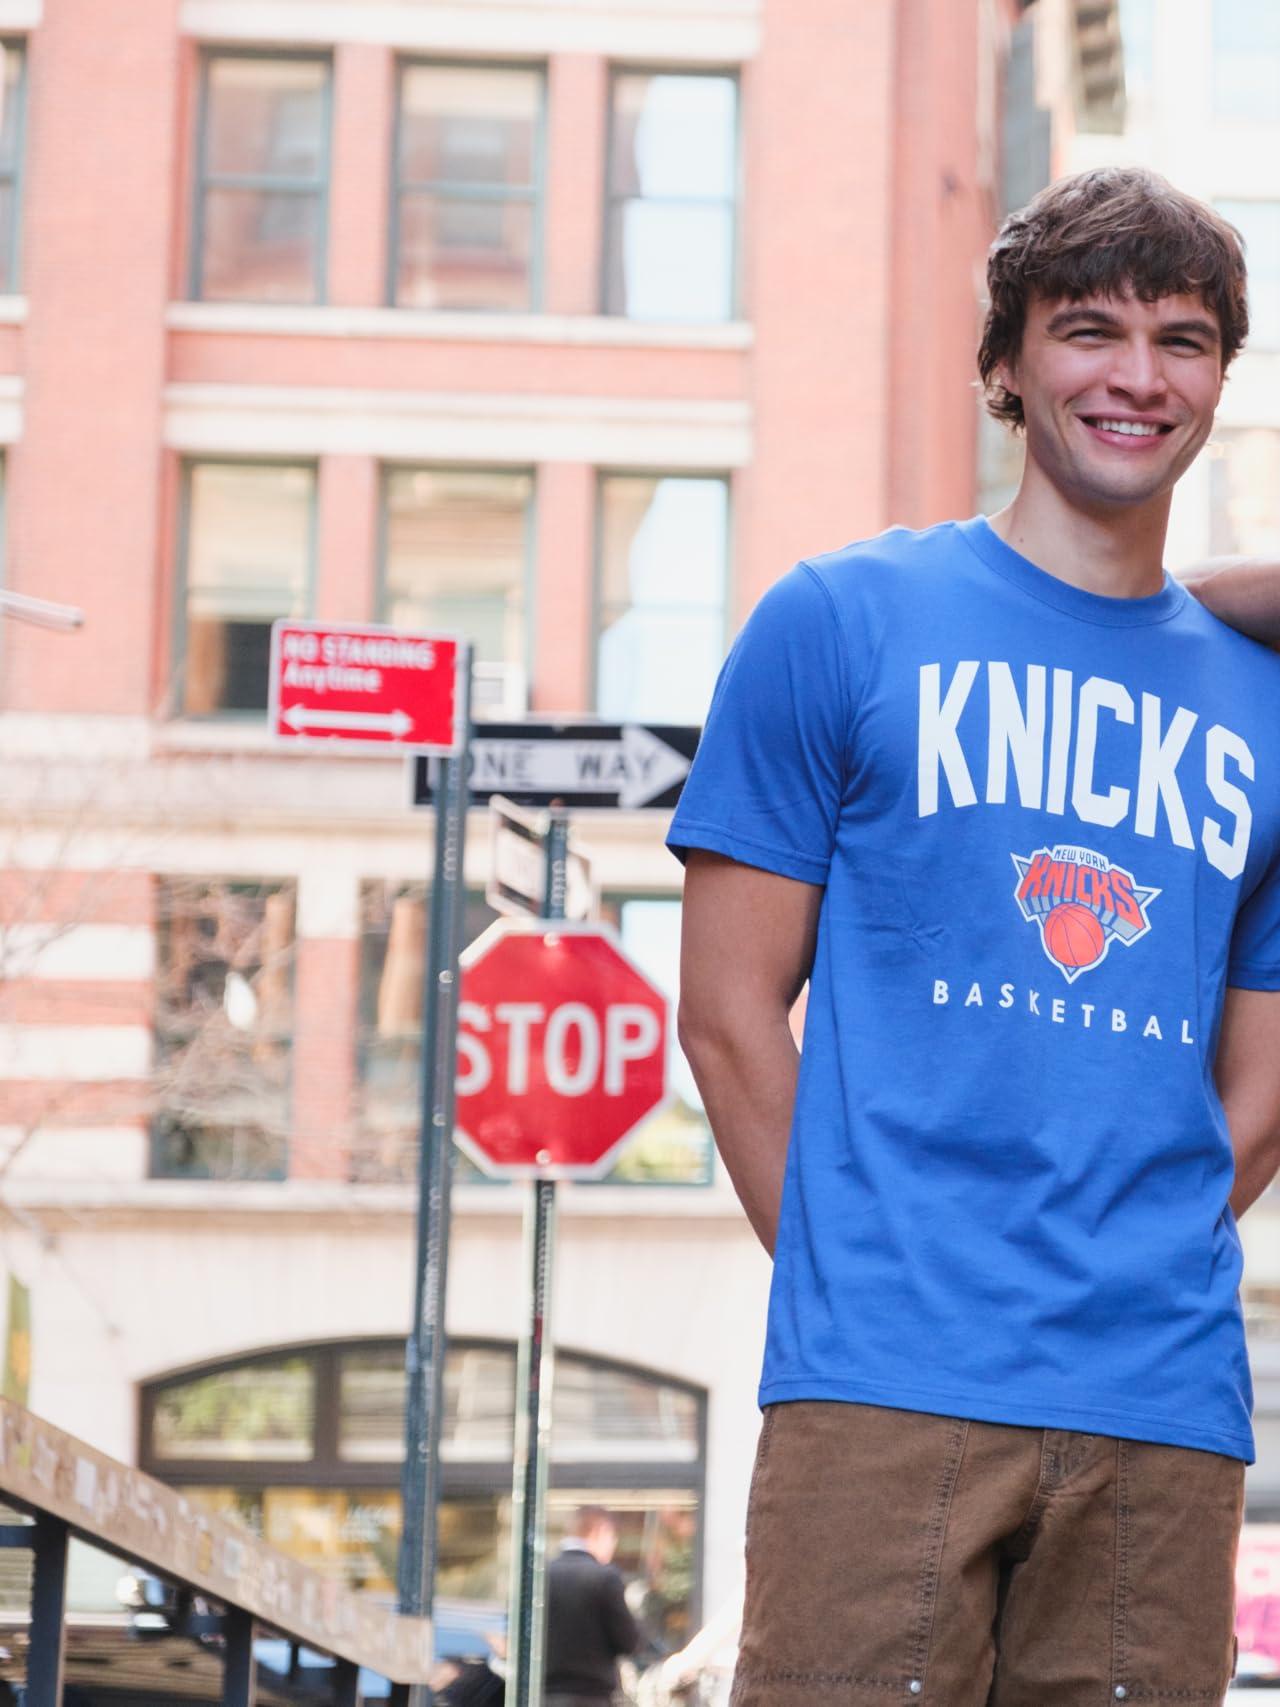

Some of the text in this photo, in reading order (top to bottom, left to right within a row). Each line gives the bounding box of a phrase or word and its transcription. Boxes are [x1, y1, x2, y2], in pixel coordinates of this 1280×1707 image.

[284, 634, 435, 670] NO STANDING
[284, 663, 381, 694] Anytime
[468, 747, 658, 786] NE WAY
[917, 660, 1255, 881] KNICKS
[1054, 848, 1107, 871] NEW YORK
[1017, 853, 1145, 930] KNICKS
[931, 980, 1195, 1044] BASKETBAL
[456, 1002, 661, 1097] STOP
